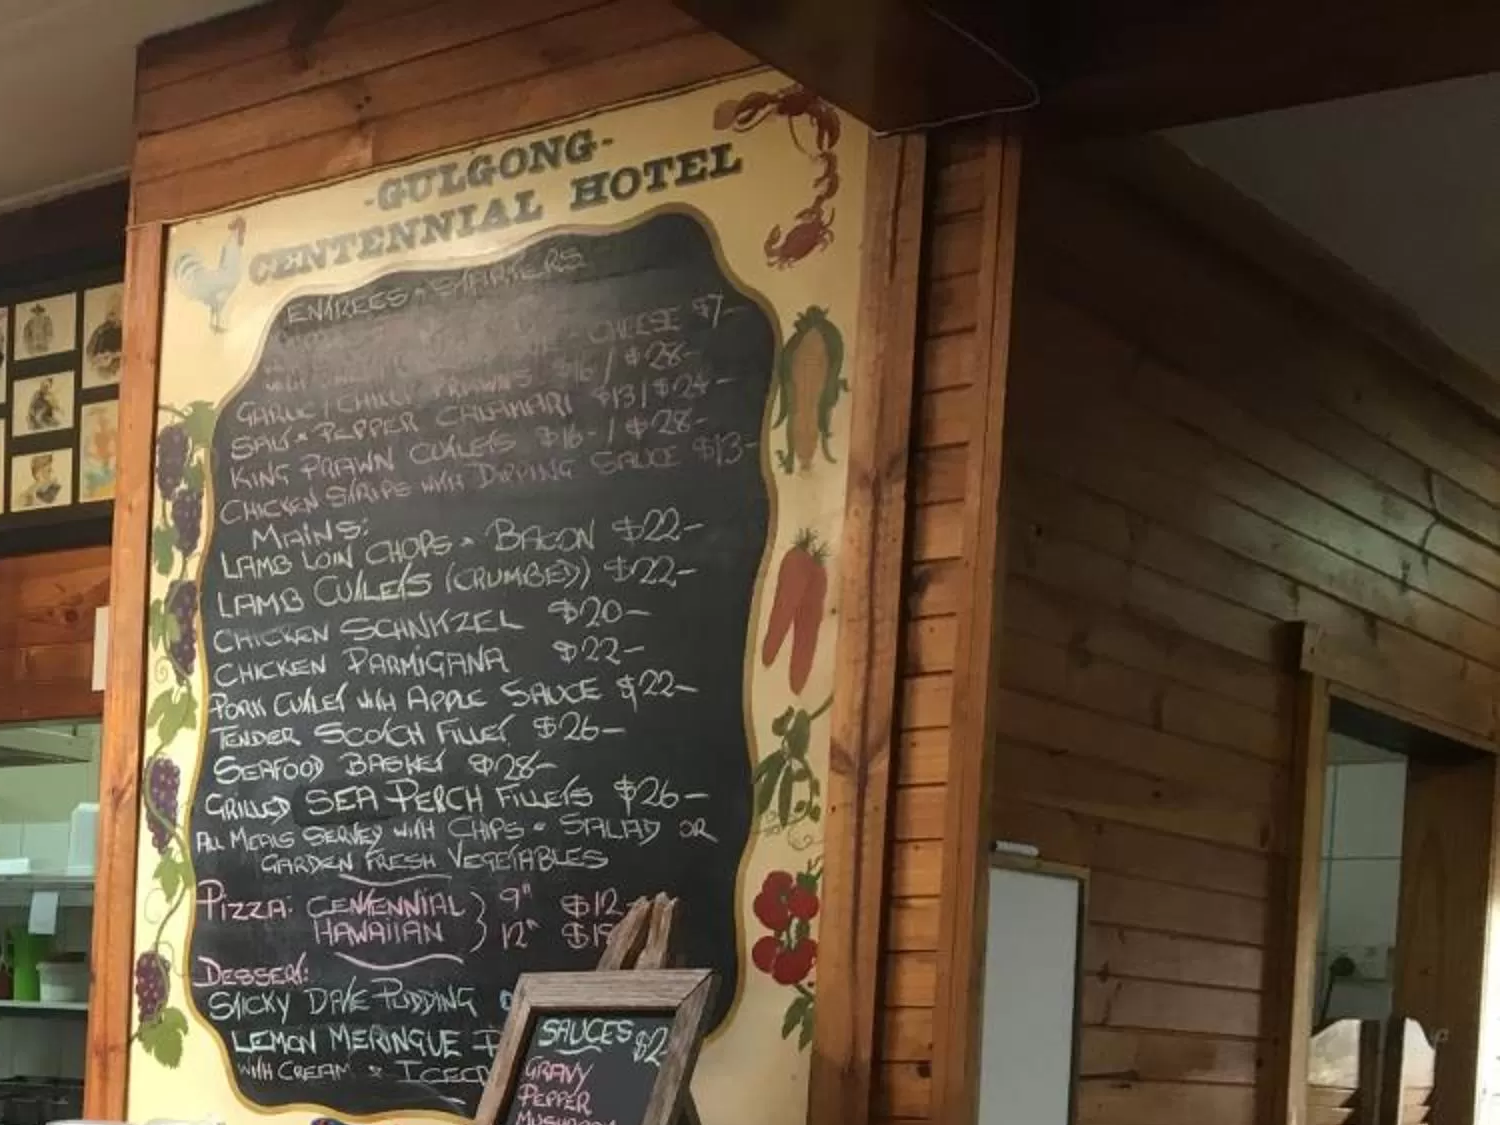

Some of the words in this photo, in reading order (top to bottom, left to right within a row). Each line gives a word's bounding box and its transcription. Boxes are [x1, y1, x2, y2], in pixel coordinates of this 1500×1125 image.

[249, 189, 544, 285] CENTENNIAL
[570, 143, 743, 211] HOTEL
[231, 425, 293, 461] SALT
[313, 411, 420, 444] PEPPER
[436, 391, 573, 428] CALAMARI
[230, 461, 292, 490] KING
[300, 446, 395, 482] PRAWN
[409, 428, 517, 464] CUTLETS
[220, 486, 320, 526] CHICKEN
[325, 477, 413, 508] STRIPS
[590, 445, 682, 476] SAUCE
[220, 550, 293, 579] LAMB
[301, 543, 354, 572] LOIN
[365, 529, 452, 566] CHOPS
[485, 517, 596, 551] BACON
[216, 587, 305, 619] LAMB
[313, 561, 434, 607] CUTLETS
[213, 621, 330, 653] CHICKEN
[340, 608, 526, 642] SCHNITZEL
[213, 652, 328, 688] CHICKEN
[209, 692, 267, 720] PORK
[273, 681, 349, 717] CUTLET
[407, 684, 488, 712] APPLE
[501, 676, 602, 708] SAUCE
[210, 724, 302, 750] TENDER
[313, 717, 426, 747] SCOTCH
[436, 713, 517, 746] FILLET
[213, 753, 325, 786] SEAFOOD
[337, 749, 448, 776] BASKET
[203, 792, 292, 826] GRILLED
[305, 785, 379, 816] SEA
[384, 777, 484, 814] PERCH
[495, 774, 593, 810] FILLETS
[195, 831, 225, 854] ALL
[230, 827, 295, 852] MEALS
[301, 822, 383, 850] SERVED
[393, 819, 436, 842] WITH
[448, 815, 525, 843] CHIPS
[558, 811, 662, 847] SALAD
[678, 817, 720, 845] OR
[261, 852, 353, 876] GARDEN
[364, 847, 437, 872] FRESH
[448, 839, 610, 873] VEGETABLES
[306, 886, 466, 918] CENTENNIAL
[308, 917, 445, 947] HAWAIIAN
[208, 989, 292, 1025] STICKY
[301, 976, 371, 1016] DATE
[370, 976, 479, 1019] PUDDING
[231, 1029, 317, 1055] LEMON
[329, 1021, 463, 1059] MERINGUE
[538, 1018, 635, 1047] SAUCES
[277, 1060, 350, 1081] CREAM
[526, 1056, 594, 1093] GRAVY
[517, 1084, 593, 1115] PEPPER
